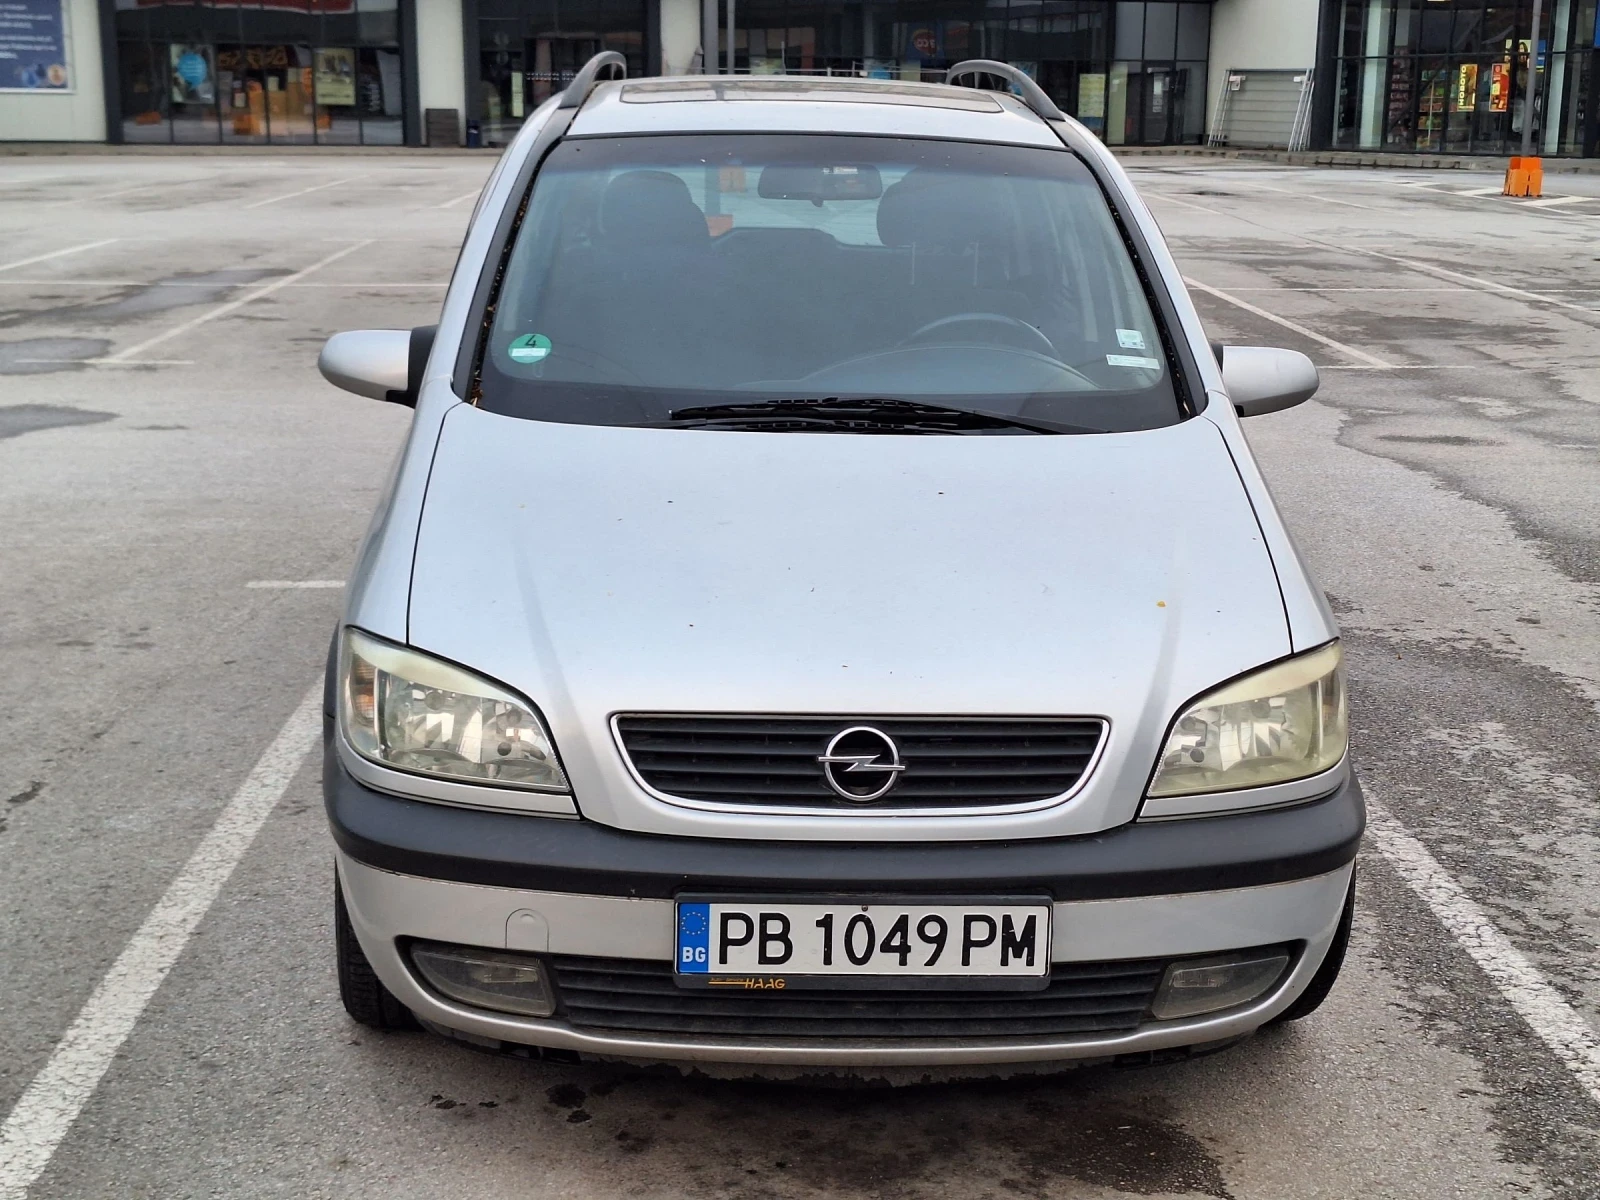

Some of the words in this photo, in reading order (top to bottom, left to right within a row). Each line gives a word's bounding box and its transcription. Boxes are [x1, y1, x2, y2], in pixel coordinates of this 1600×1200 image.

[524, 334, 537, 348] 4
[719, 911, 793, 965] PB
[815, 913, 948, 967] 1049
[961, 914, 1037, 967] PM
[682, 946, 706, 963] BG
[745, 977, 786, 989] HAAG
